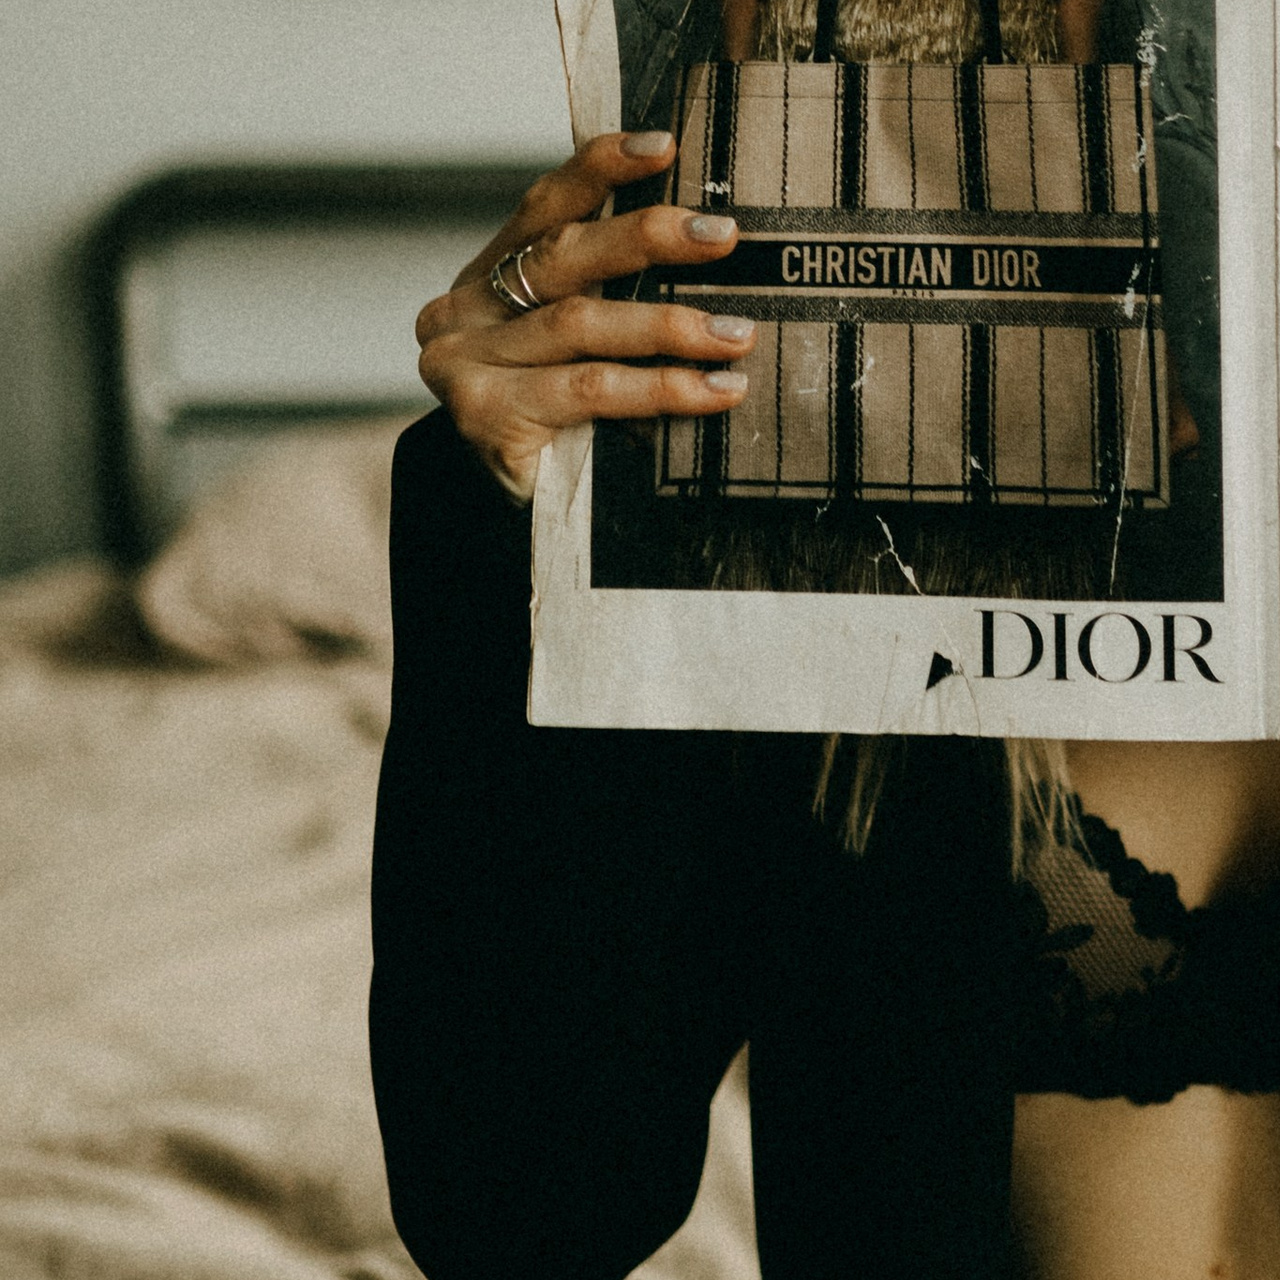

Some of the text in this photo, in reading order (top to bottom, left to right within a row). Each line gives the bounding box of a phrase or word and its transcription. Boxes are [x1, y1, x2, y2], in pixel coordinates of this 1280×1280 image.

[781, 245, 1042, 288] CHRISTIAN DIOR
[891, 288, 936, 299] PARIS
[973, 609, 1226, 684] DIOR
